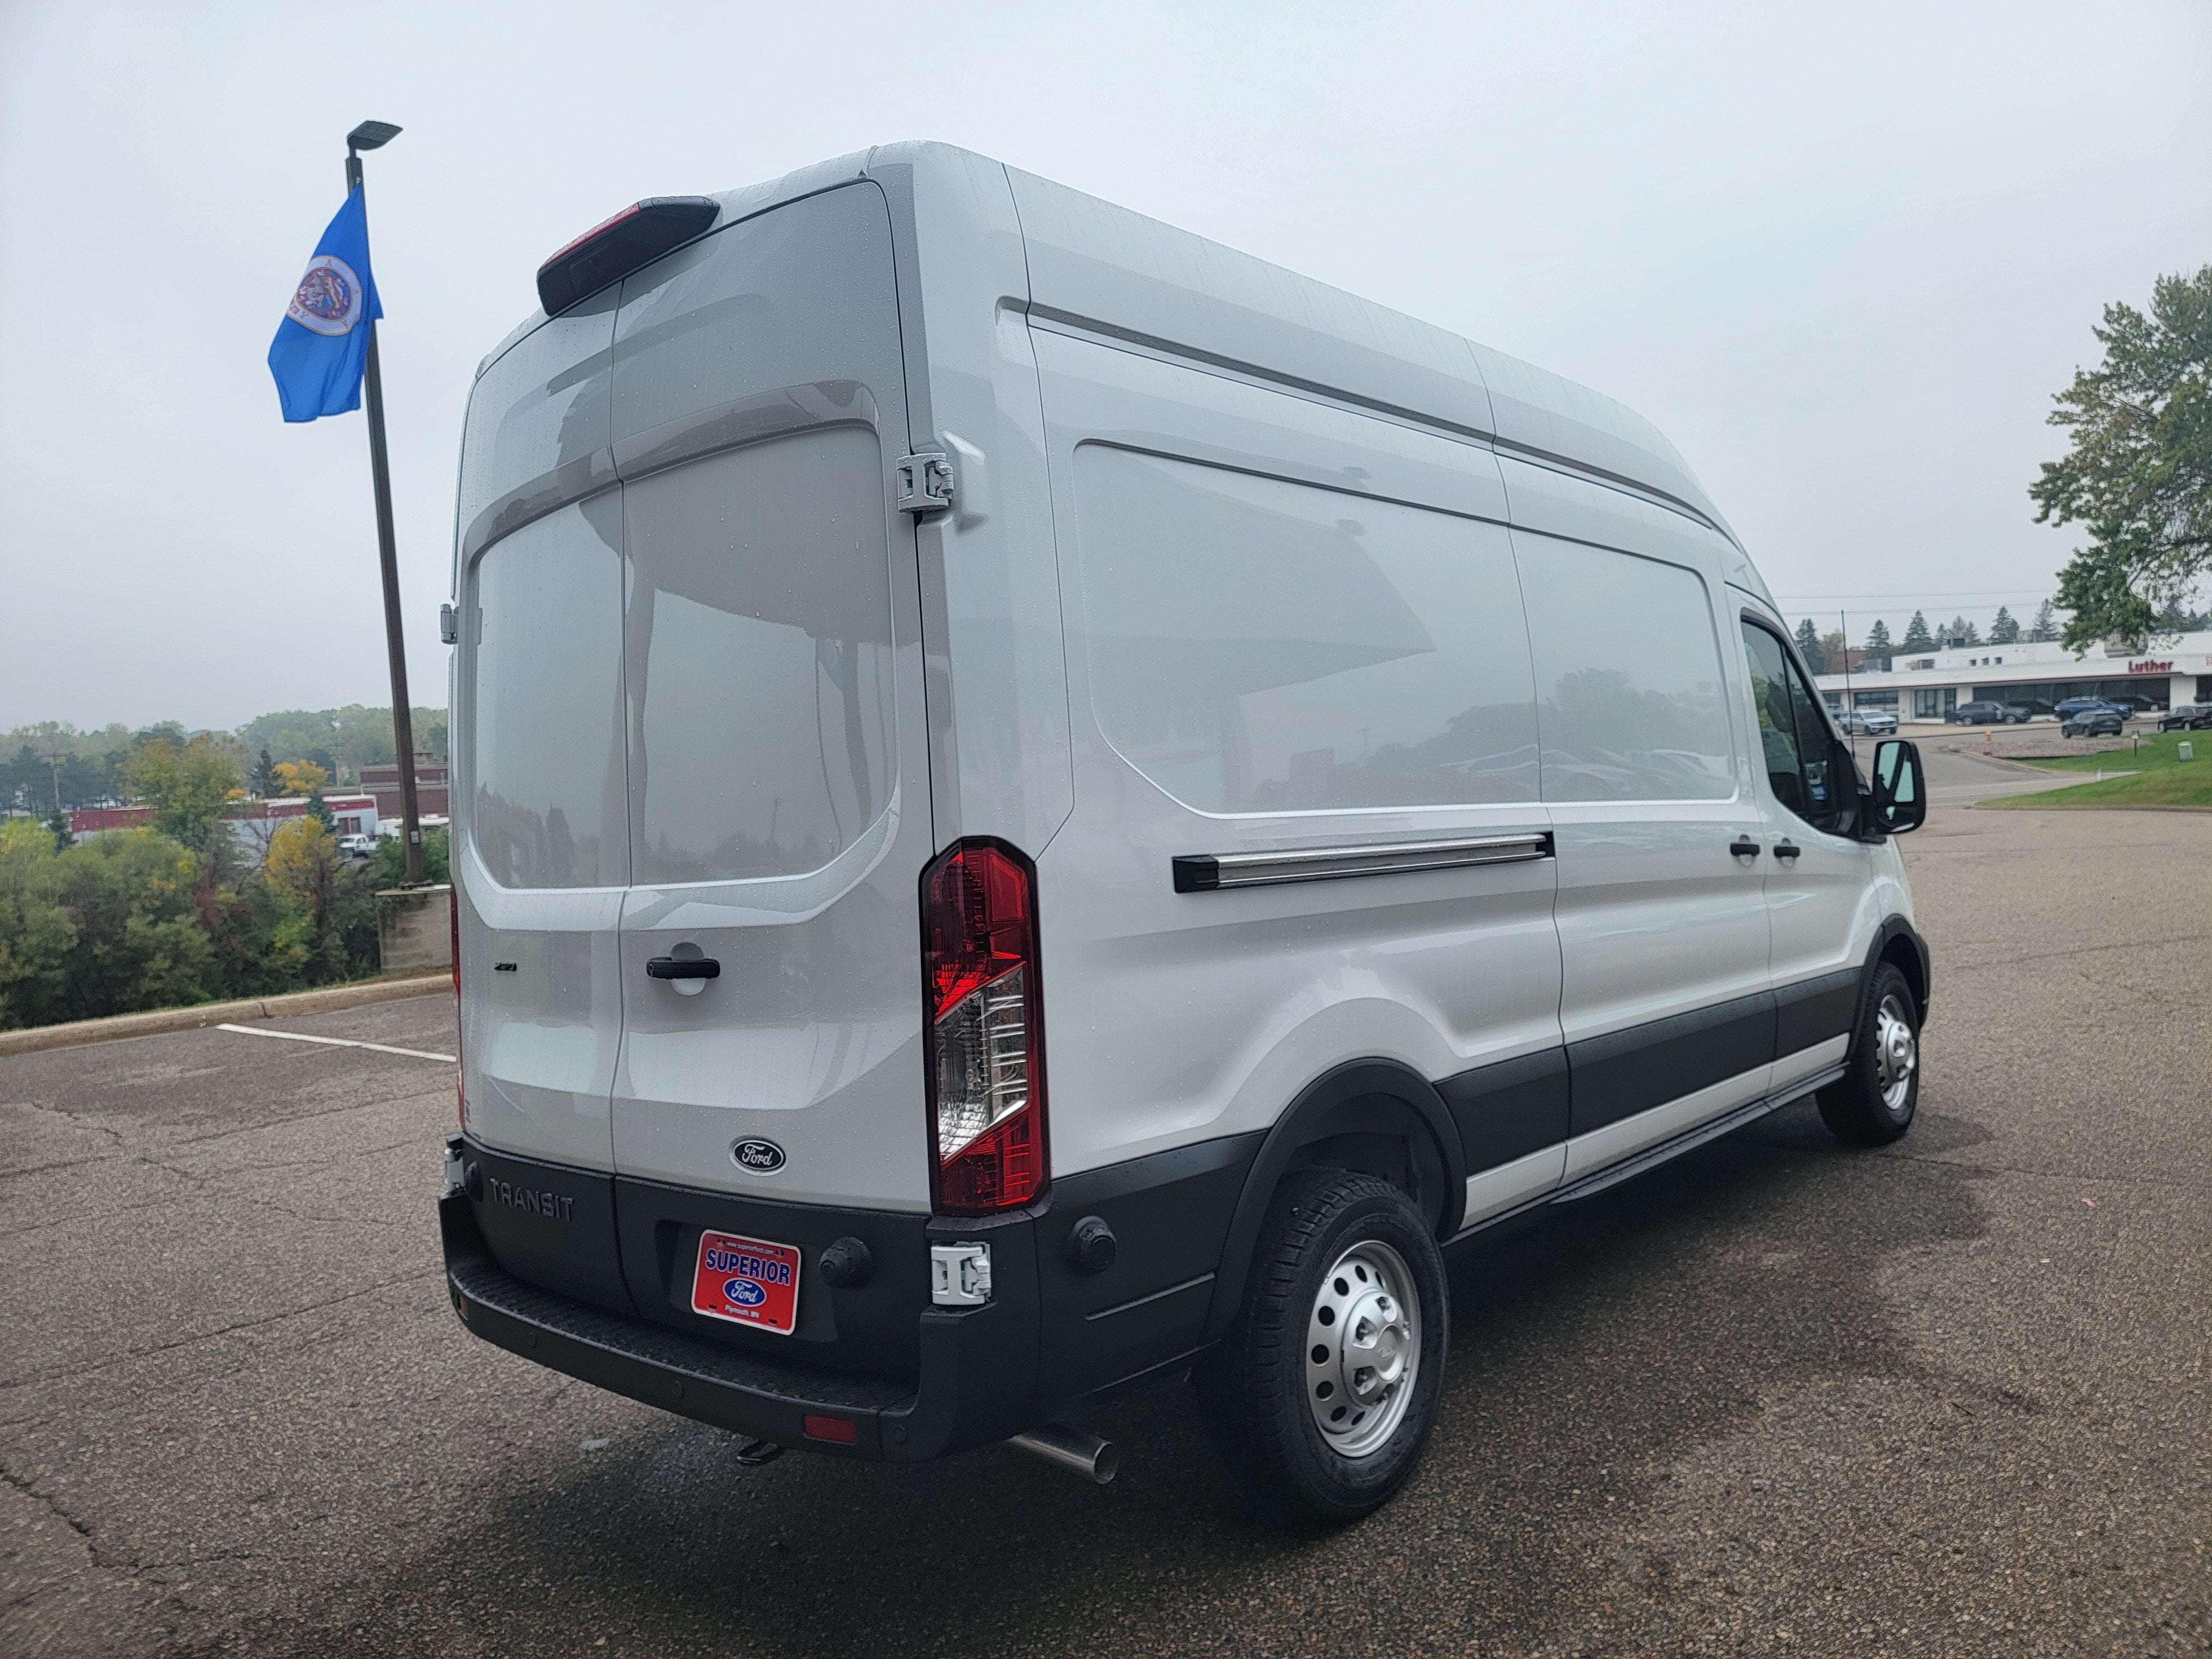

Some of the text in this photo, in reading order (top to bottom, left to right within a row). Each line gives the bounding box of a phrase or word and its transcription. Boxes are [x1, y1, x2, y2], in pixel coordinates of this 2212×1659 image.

[2128, 660, 2173, 672] Luther
[742, 1144, 773, 1166] Ford
[490, 1177, 573, 1222] TRANSIT
[706, 1248, 790, 1286] SUPERIOR
[731, 1281, 758, 1302] Ford
